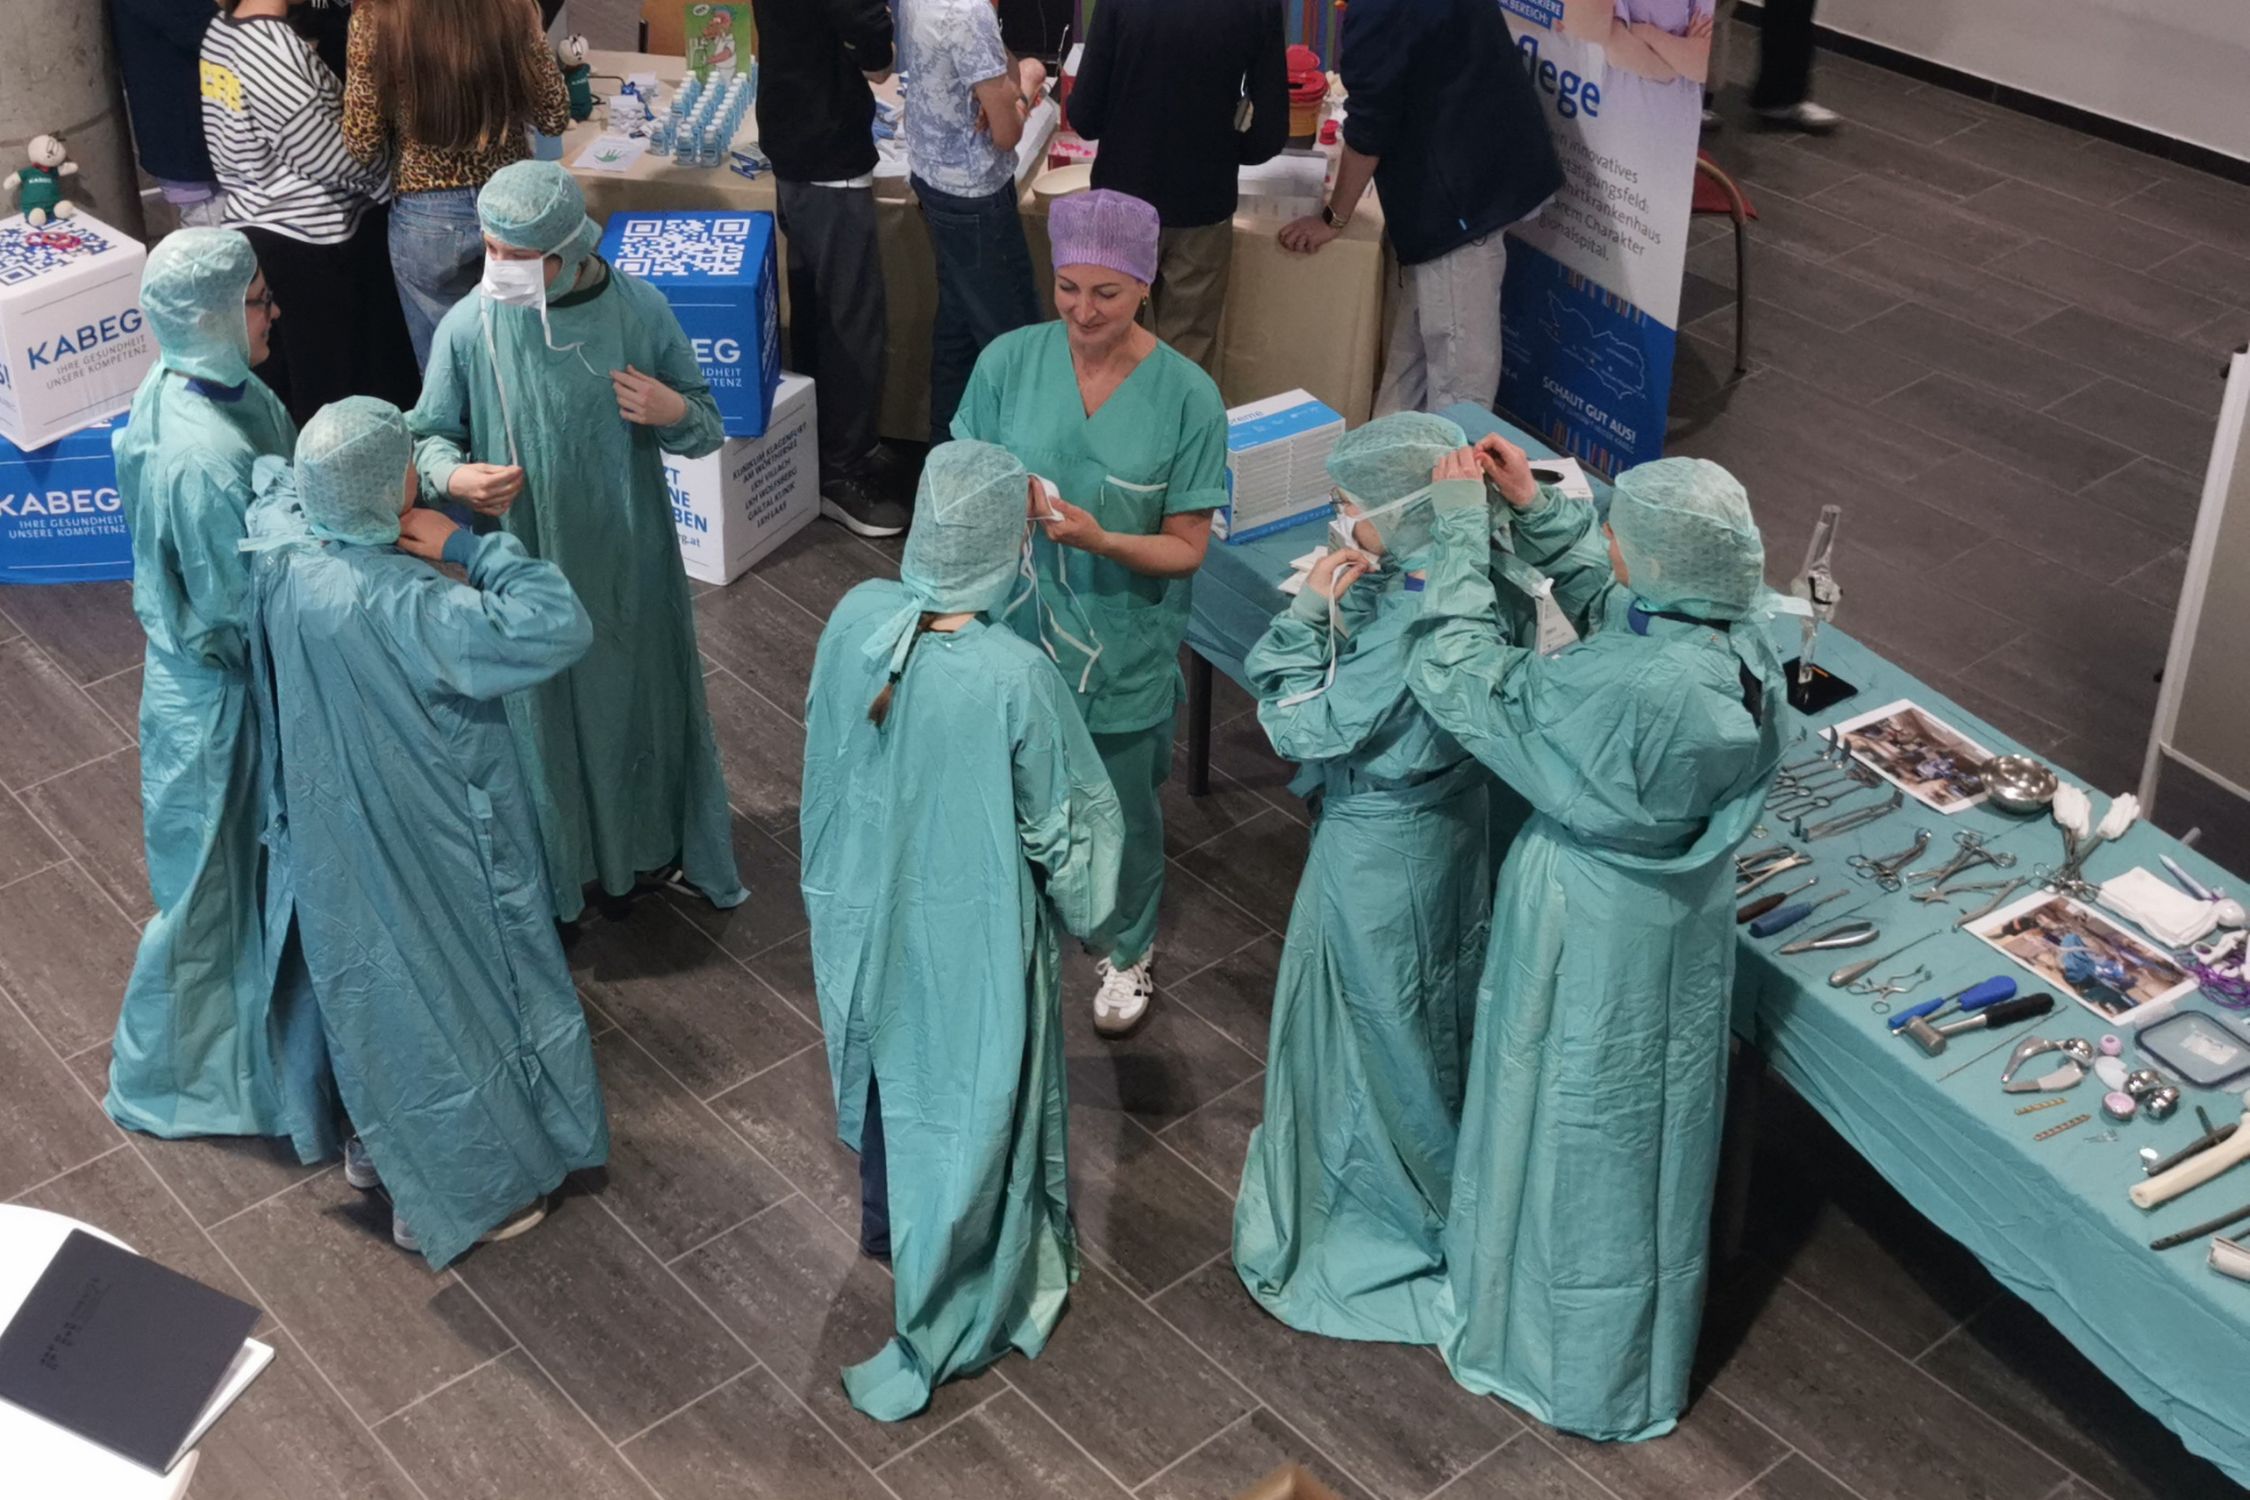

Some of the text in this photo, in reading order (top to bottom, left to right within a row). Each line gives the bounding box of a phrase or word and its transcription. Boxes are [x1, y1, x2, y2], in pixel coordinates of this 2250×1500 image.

[1569, 142, 1638, 184] innovatives
[1584, 214, 1646, 256] Charakter
[27, 308, 143, 370] KABEG
[57, 335, 146, 375] IHRE GESUNDHEIT
[691, 338, 741, 363] EG
[46, 344, 148, 390] UNSERE KOMPETENZ
[1543, 376, 1584, 410] SCHAUT
[1585, 403, 1608, 426] GUT
[1609, 418, 1637, 444] AUS!
[0, 487, 121, 516] KABEG
[667, 486, 690, 508] NE
[9, 525, 127, 539] UNSERE KOMPETENZ
[19, 515, 124, 529] IHRE GESUNDHEIT
[671, 506, 707, 533] BEN
